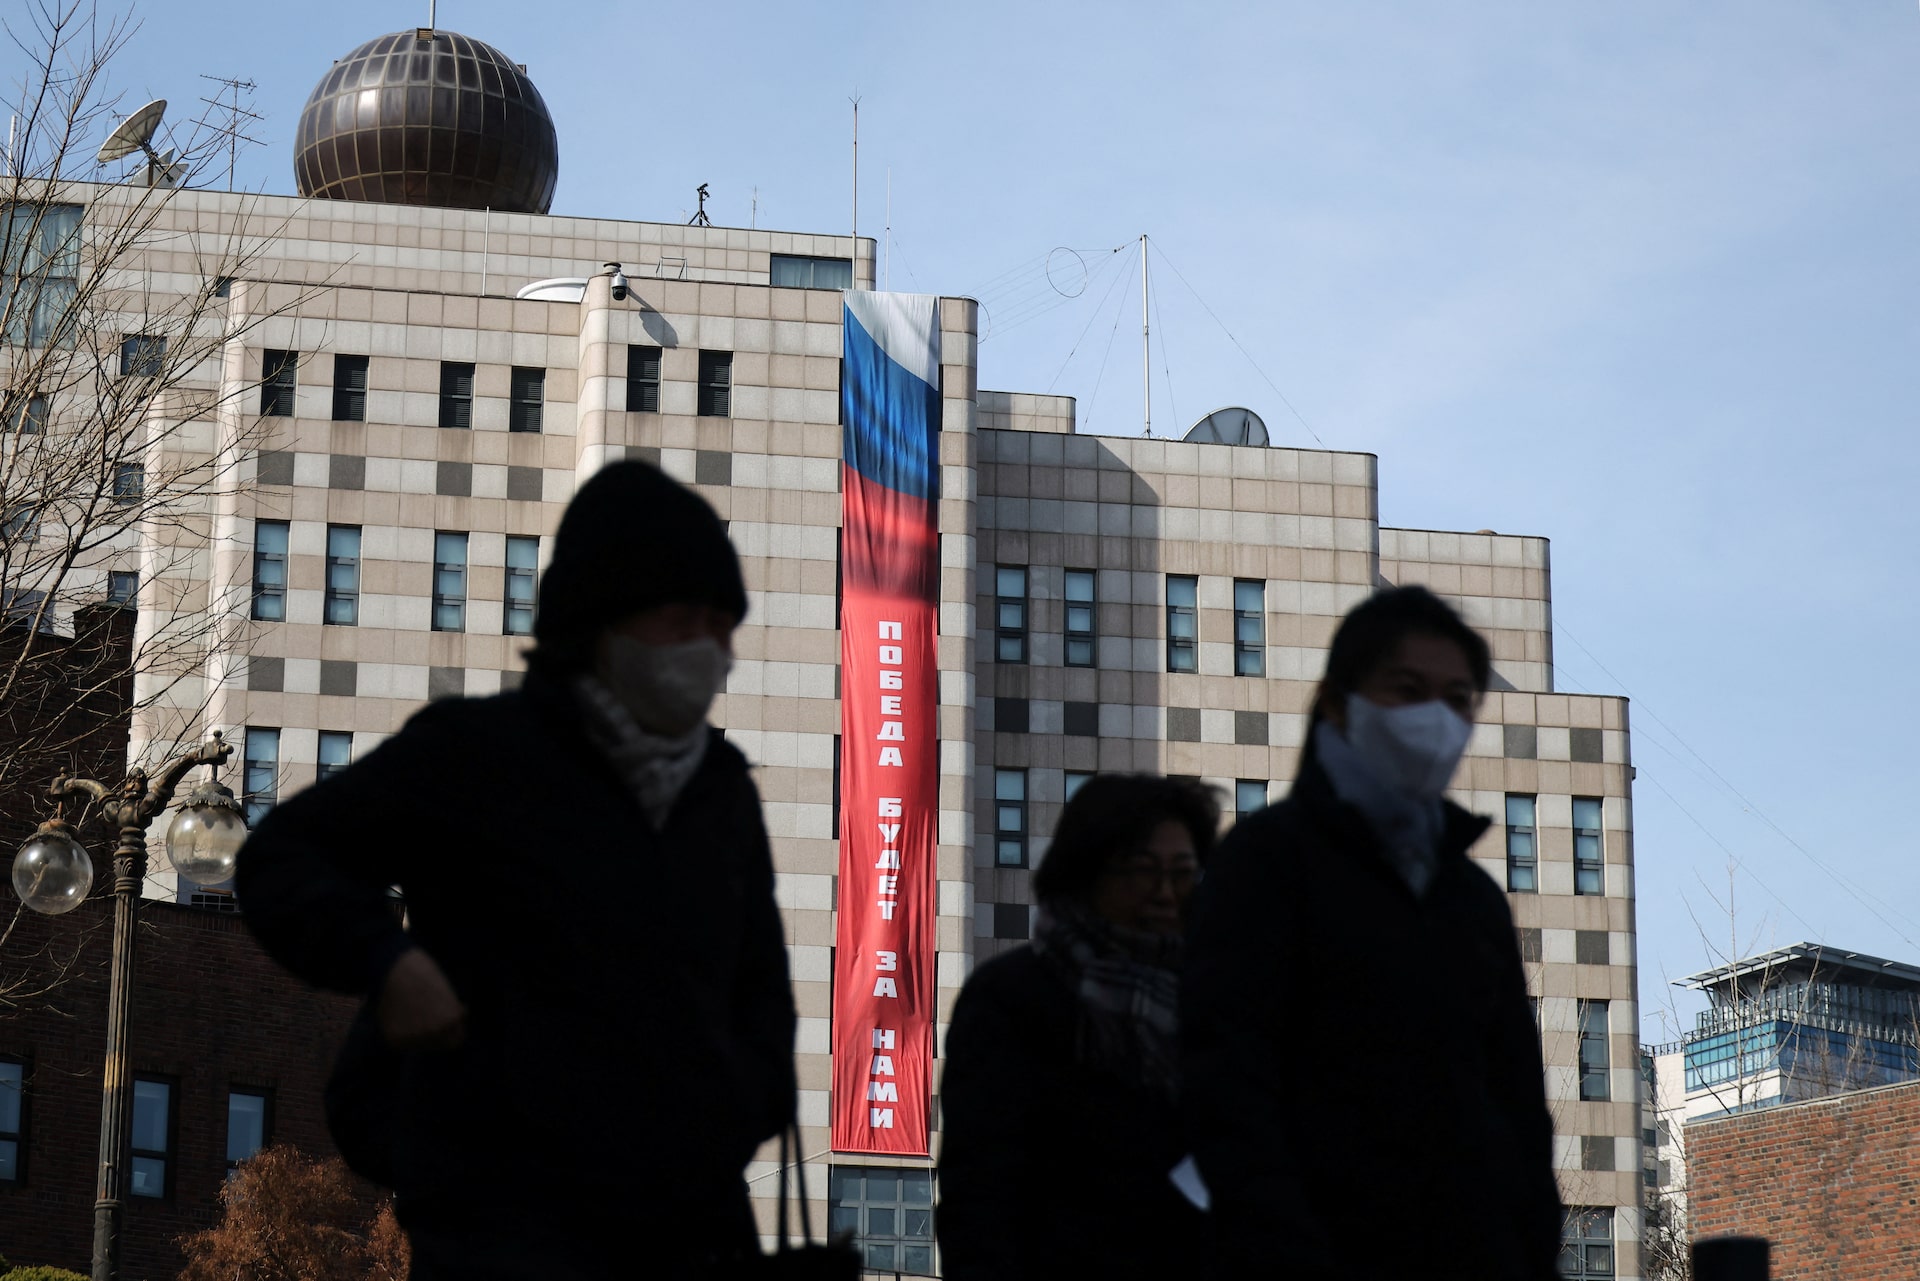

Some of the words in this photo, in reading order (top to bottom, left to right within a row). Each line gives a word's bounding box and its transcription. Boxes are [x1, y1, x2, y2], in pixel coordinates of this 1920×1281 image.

[877, 620, 905, 767] ПОБЕДА
[875, 797, 902, 920] БУДЕТ
[873, 951, 898, 998] ЗА
[866, 1028, 899, 1129] НАМИ
